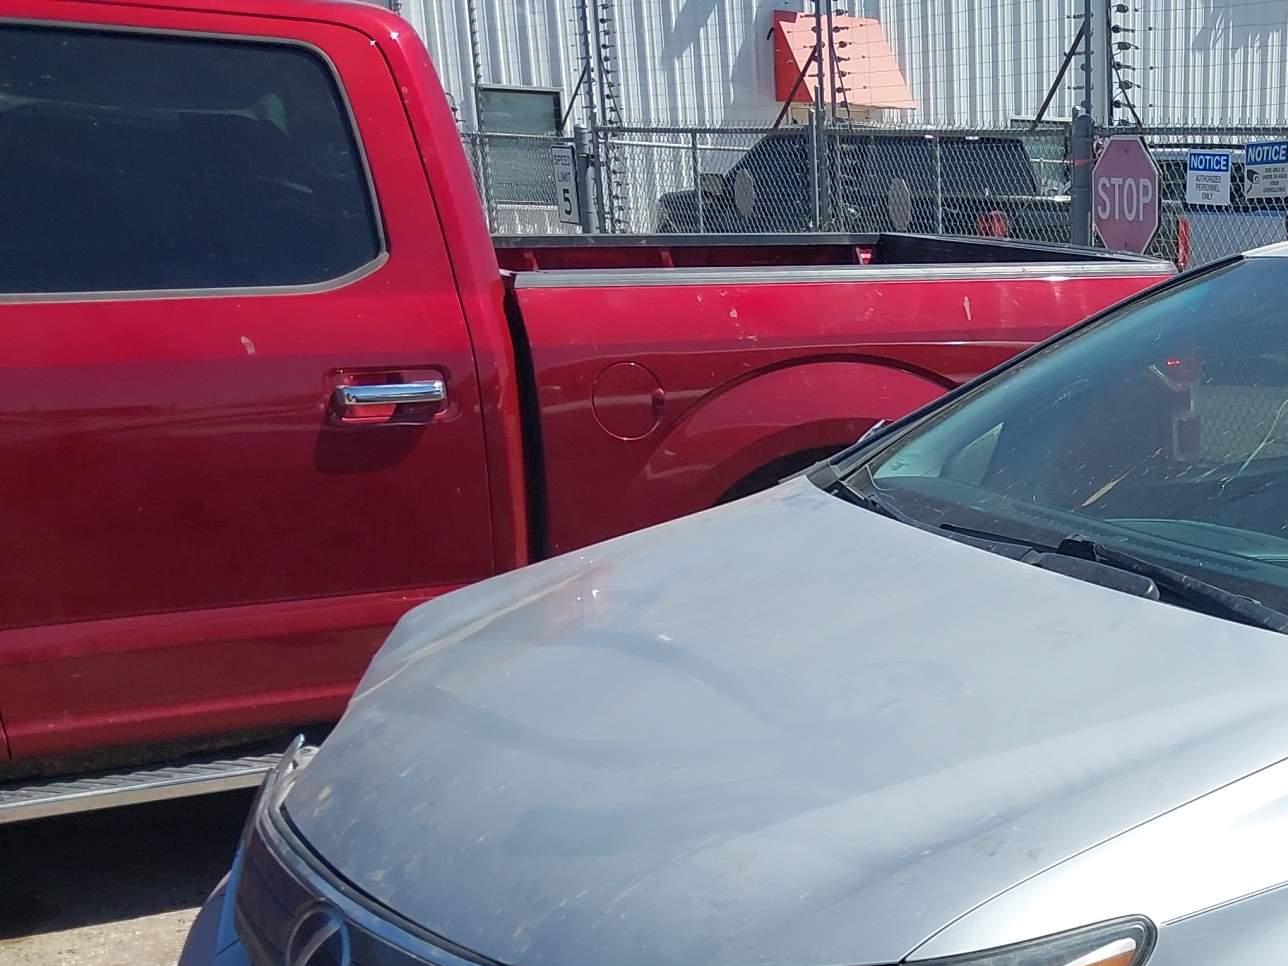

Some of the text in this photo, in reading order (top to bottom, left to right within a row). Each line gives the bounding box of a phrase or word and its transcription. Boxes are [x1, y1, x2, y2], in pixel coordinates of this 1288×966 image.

[1247, 143, 1287, 163] NOTICE
[554, 154, 571, 166] SPEED
[1190, 155, 1227, 170] NOTICE
[558, 172, 571, 182] LIMIT
[1195, 175, 1222, 183] AUTHORIZED
[1195, 183, 1221, 192] PERSONNEL
[563, 188, 572, 216] 5
[1097, 176, 1153, 222] STOP
[1201, 192, 1213, 200] ONLY
